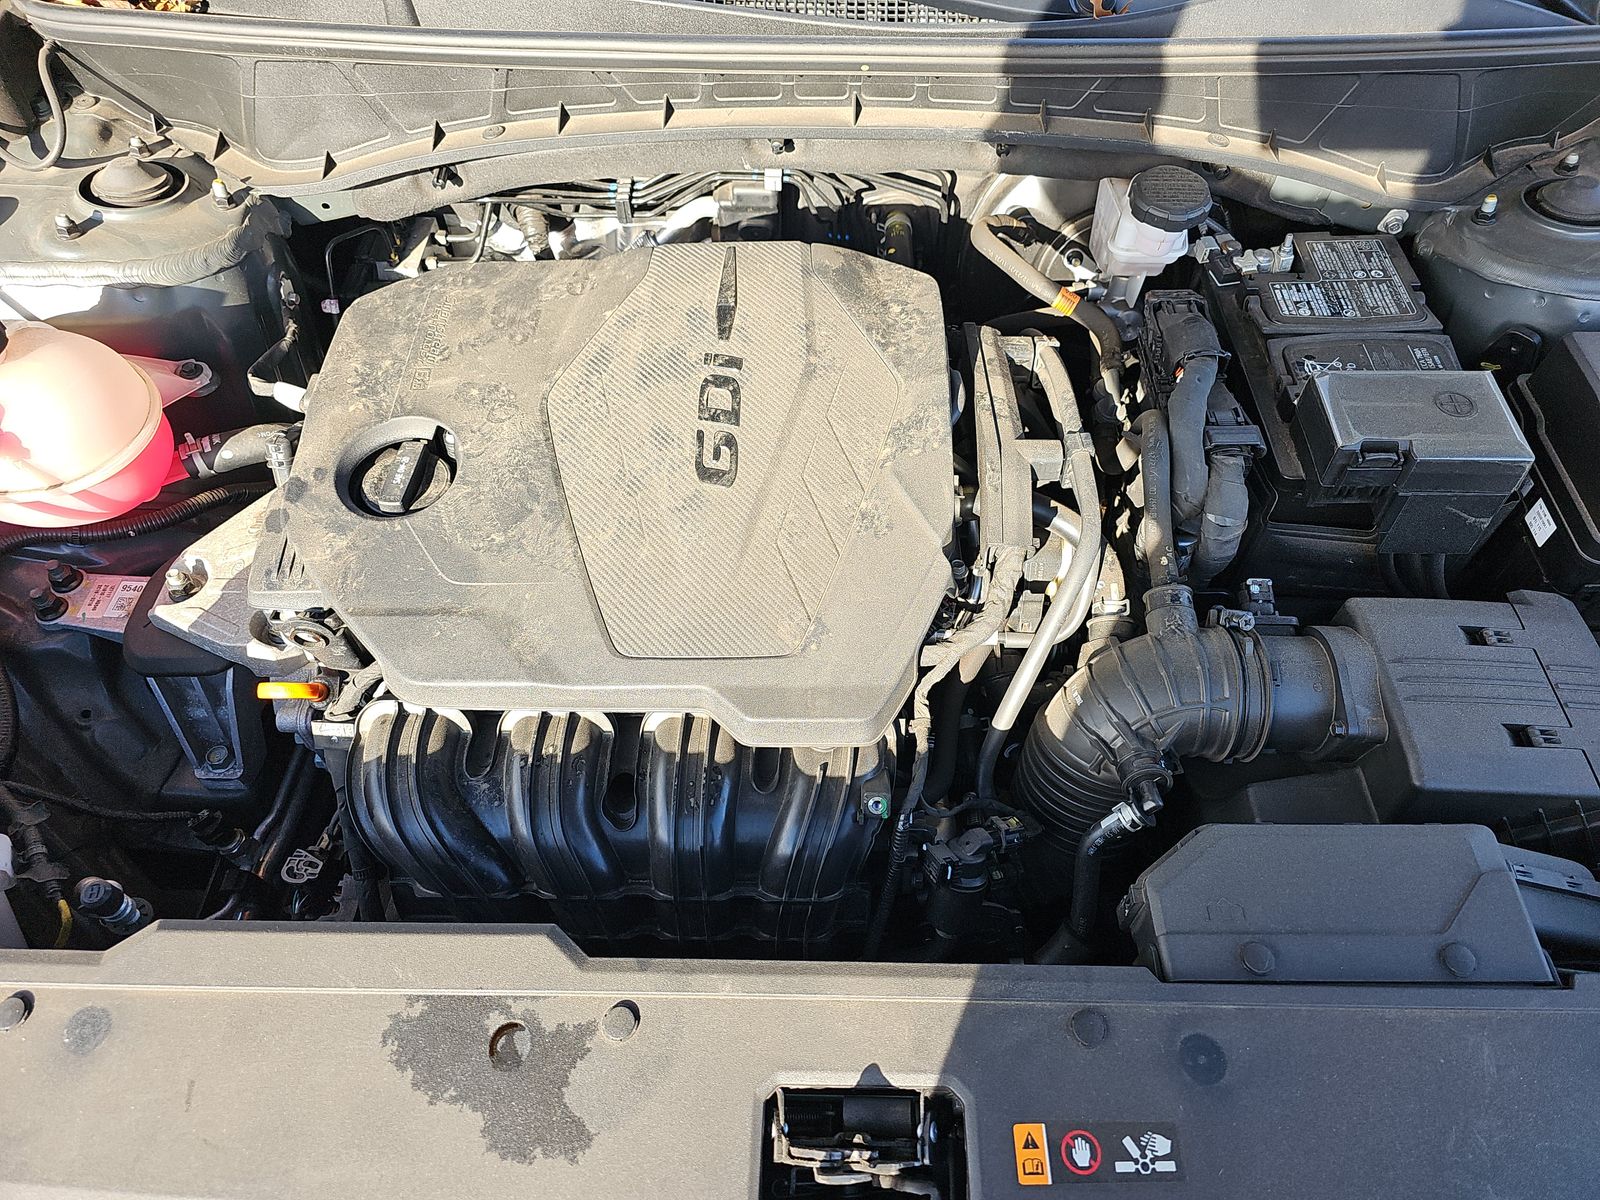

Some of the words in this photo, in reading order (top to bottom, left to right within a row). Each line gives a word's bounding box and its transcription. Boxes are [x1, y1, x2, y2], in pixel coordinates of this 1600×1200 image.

[695, 353, 743, 488] GDi
[392, 473, 404, 485] SAE
[121, 584, 144, 593] 9540
